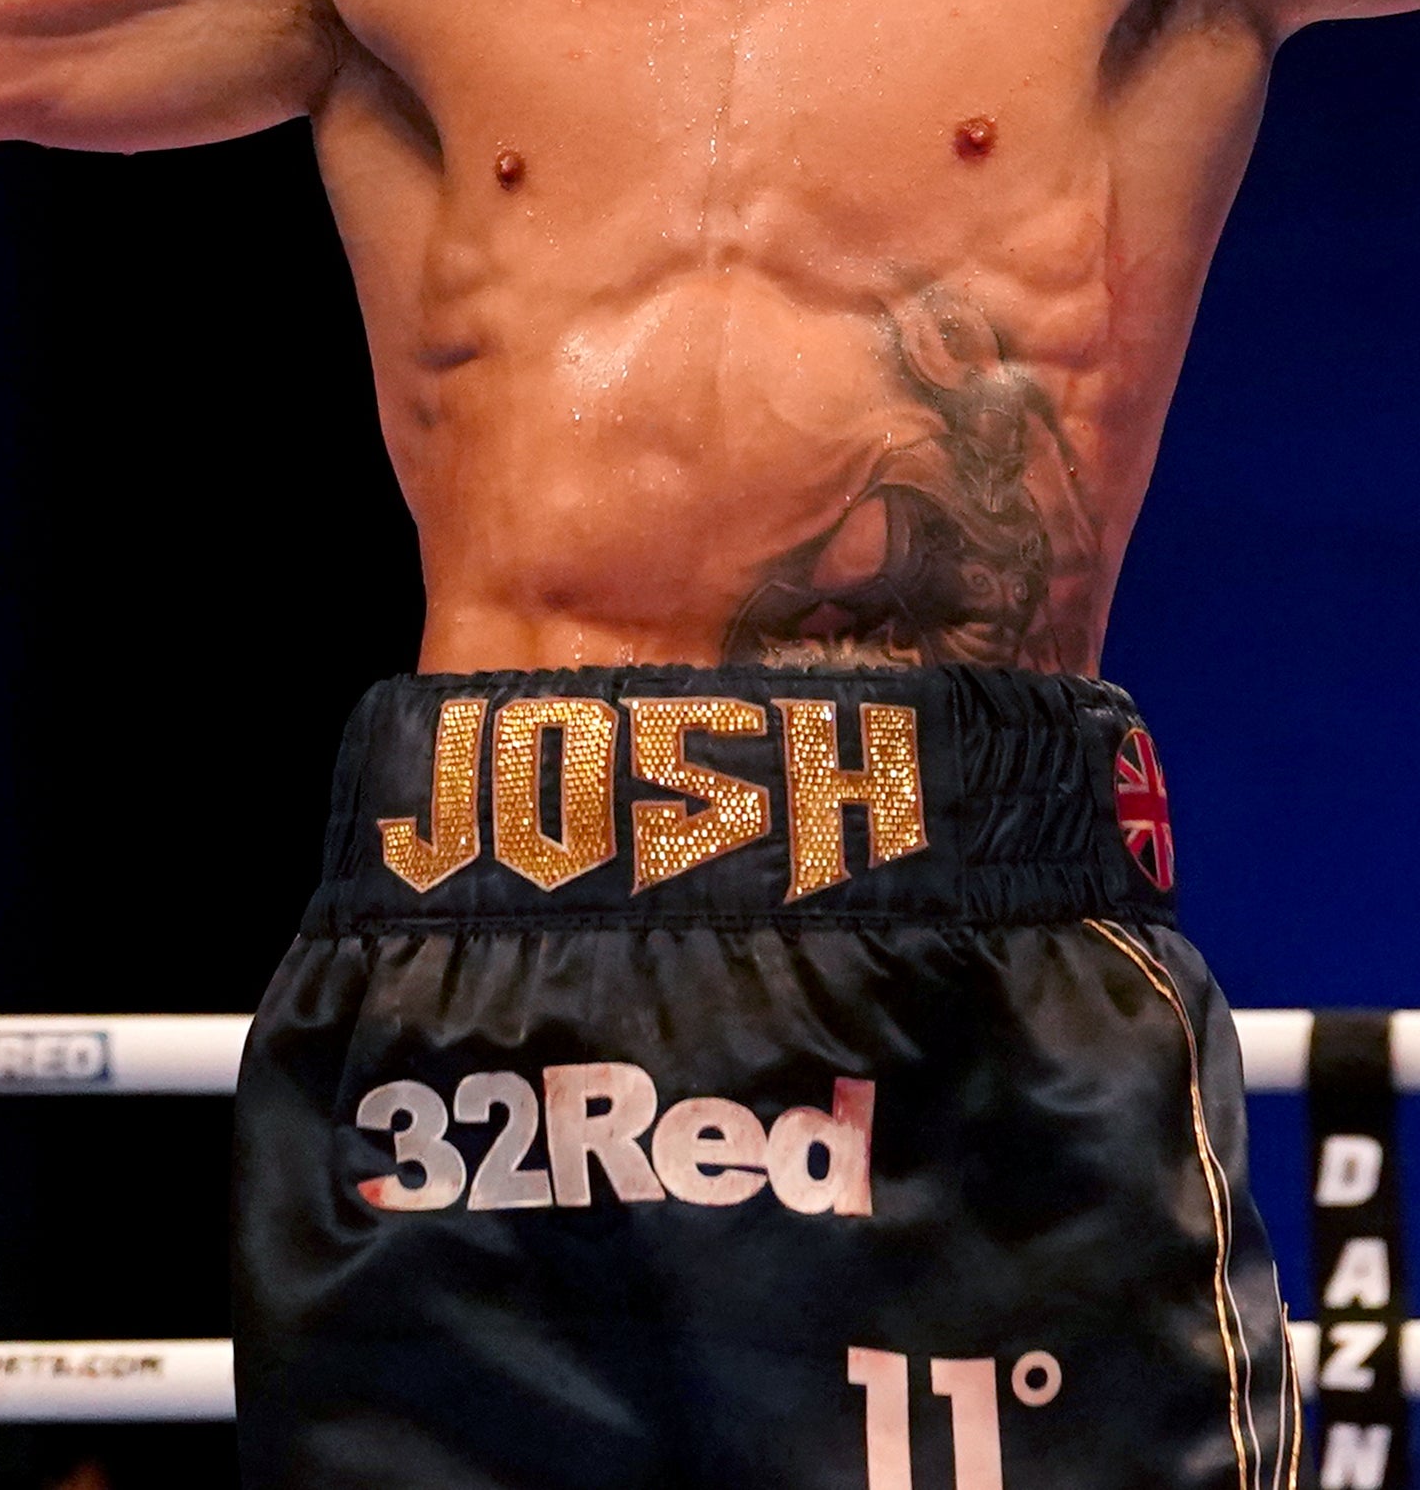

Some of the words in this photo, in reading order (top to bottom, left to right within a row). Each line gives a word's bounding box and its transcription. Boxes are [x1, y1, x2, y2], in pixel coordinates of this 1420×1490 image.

[377, 696, 928, 903] JOSH
[355, 1061, 876, 1217] 32Red
[1314, 1134, 1391, 1490] DAZN
